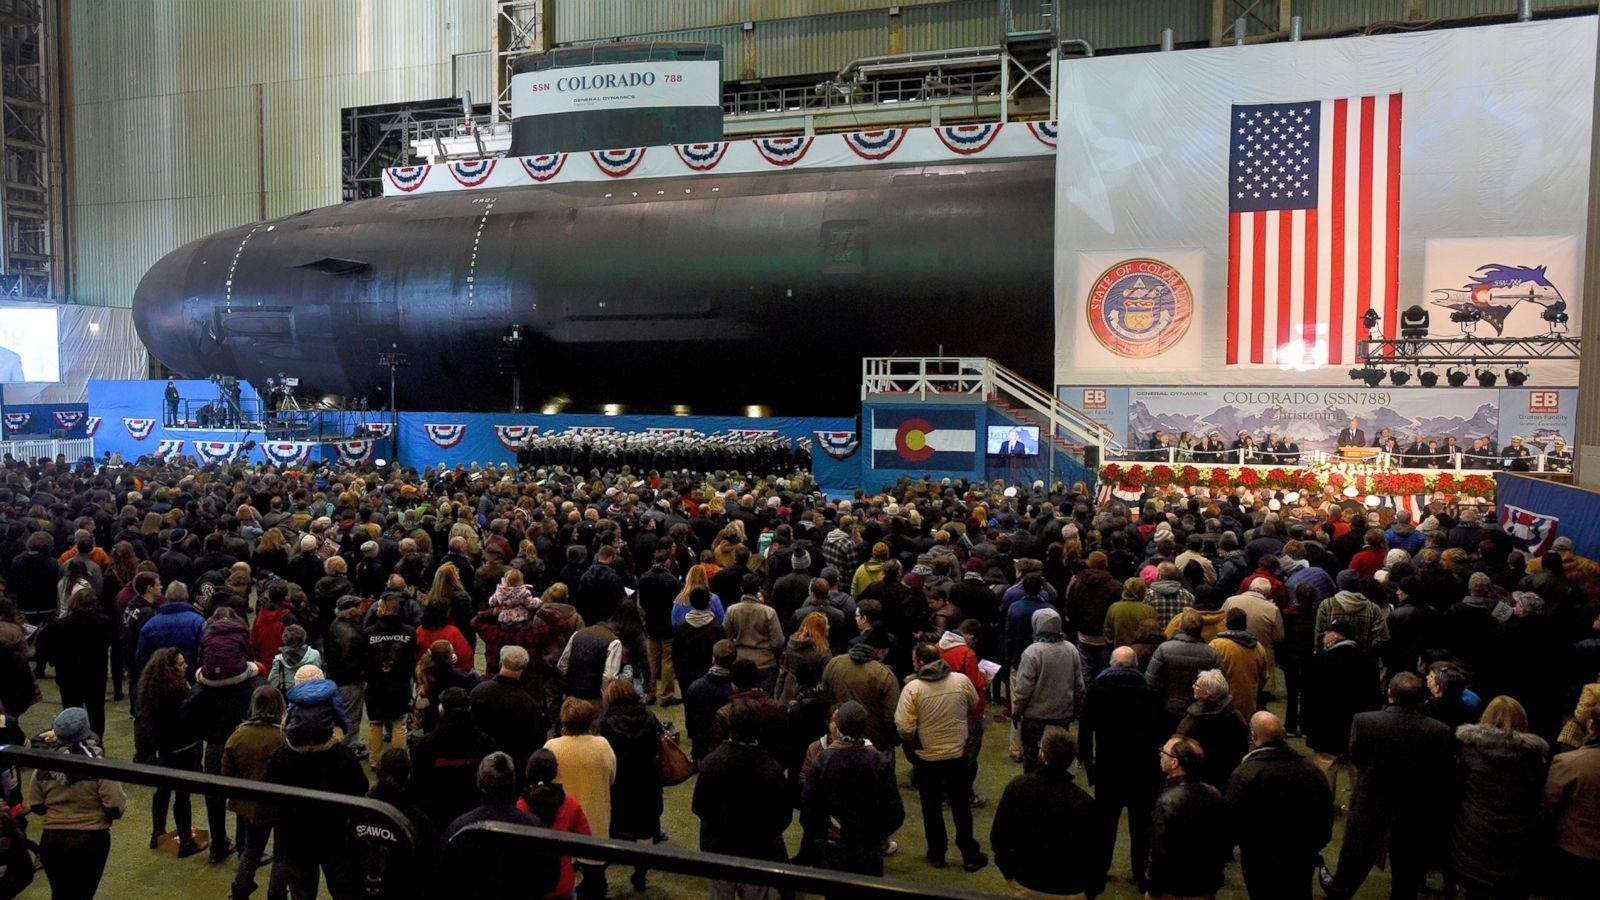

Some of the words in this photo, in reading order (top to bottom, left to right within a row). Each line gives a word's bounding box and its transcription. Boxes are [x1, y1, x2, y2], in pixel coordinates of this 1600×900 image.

[532, 83, 550, 92] SSN
[556, 71, 656, 92] COLORADO
[664, 74, 683, 83] 788
[1092, 275, 1114, 310] STATE
[1115, 264, 1132, 277] OF
[1084, 390, 1106, 403] EB
[1223, 392, 1319, 405] COLORADO
[1323, 391, 1392, 406] (SSN788)
[1531, 392, 1558, 407] EB
[369, 634, 411, 645] SEAWOLF
[355, 824, 398, 842] SEAWOL
